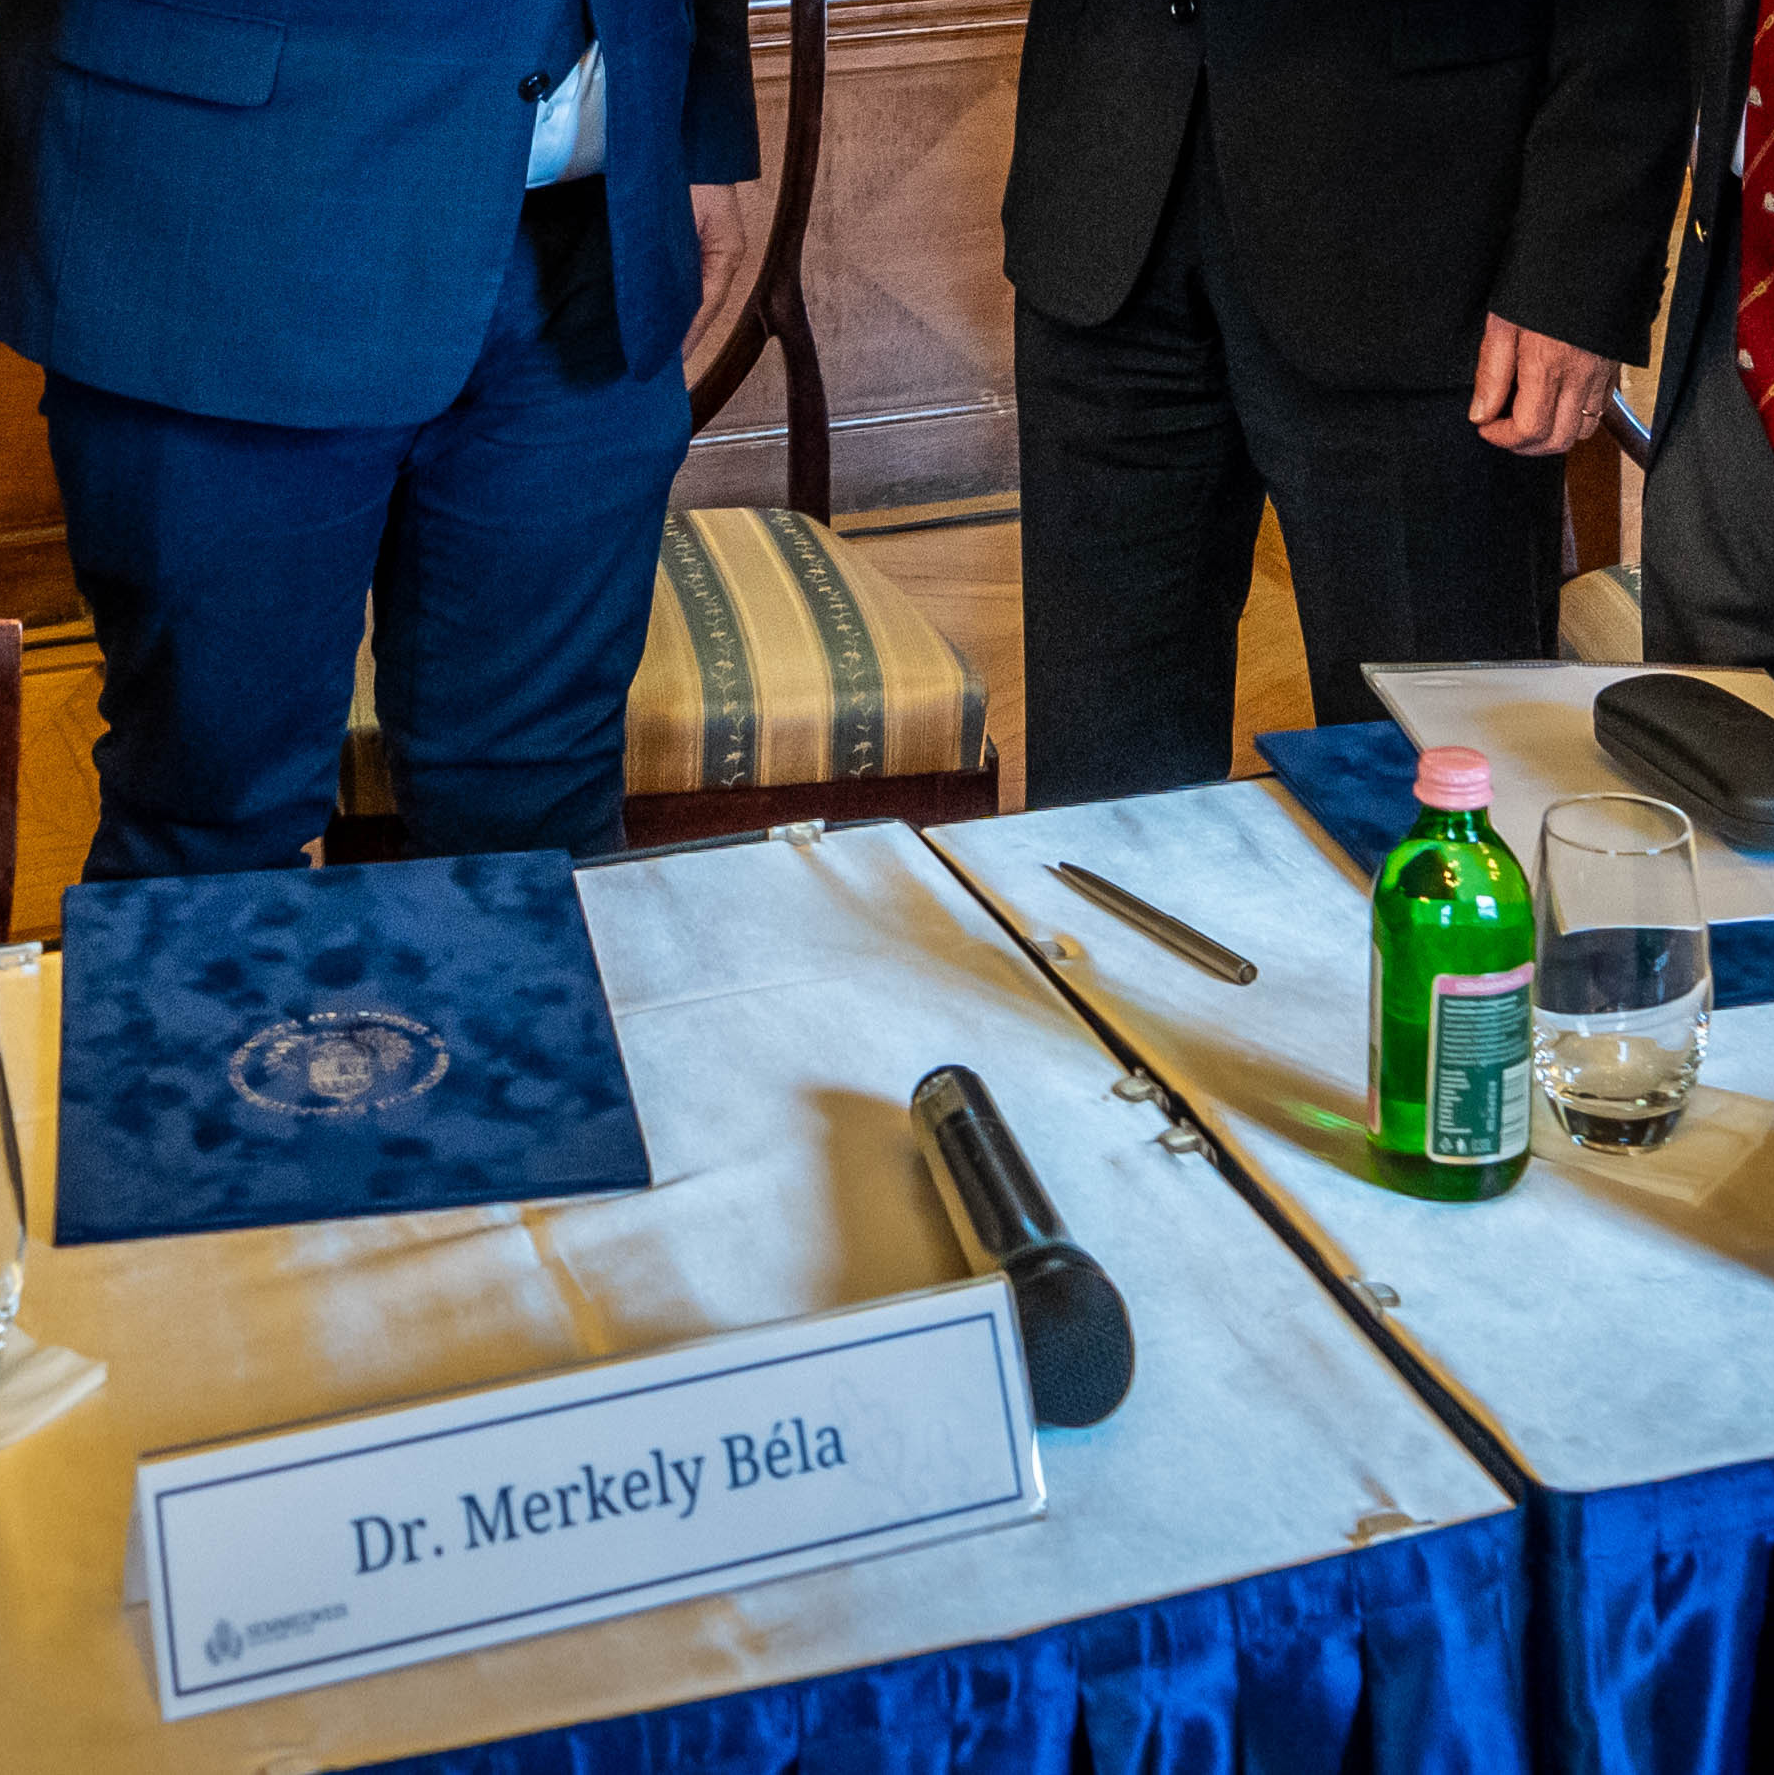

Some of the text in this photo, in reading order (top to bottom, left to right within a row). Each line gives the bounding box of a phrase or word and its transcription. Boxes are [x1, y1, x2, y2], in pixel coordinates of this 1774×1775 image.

[350, 1415, 850, 1578] Dr. Merkely Béla
